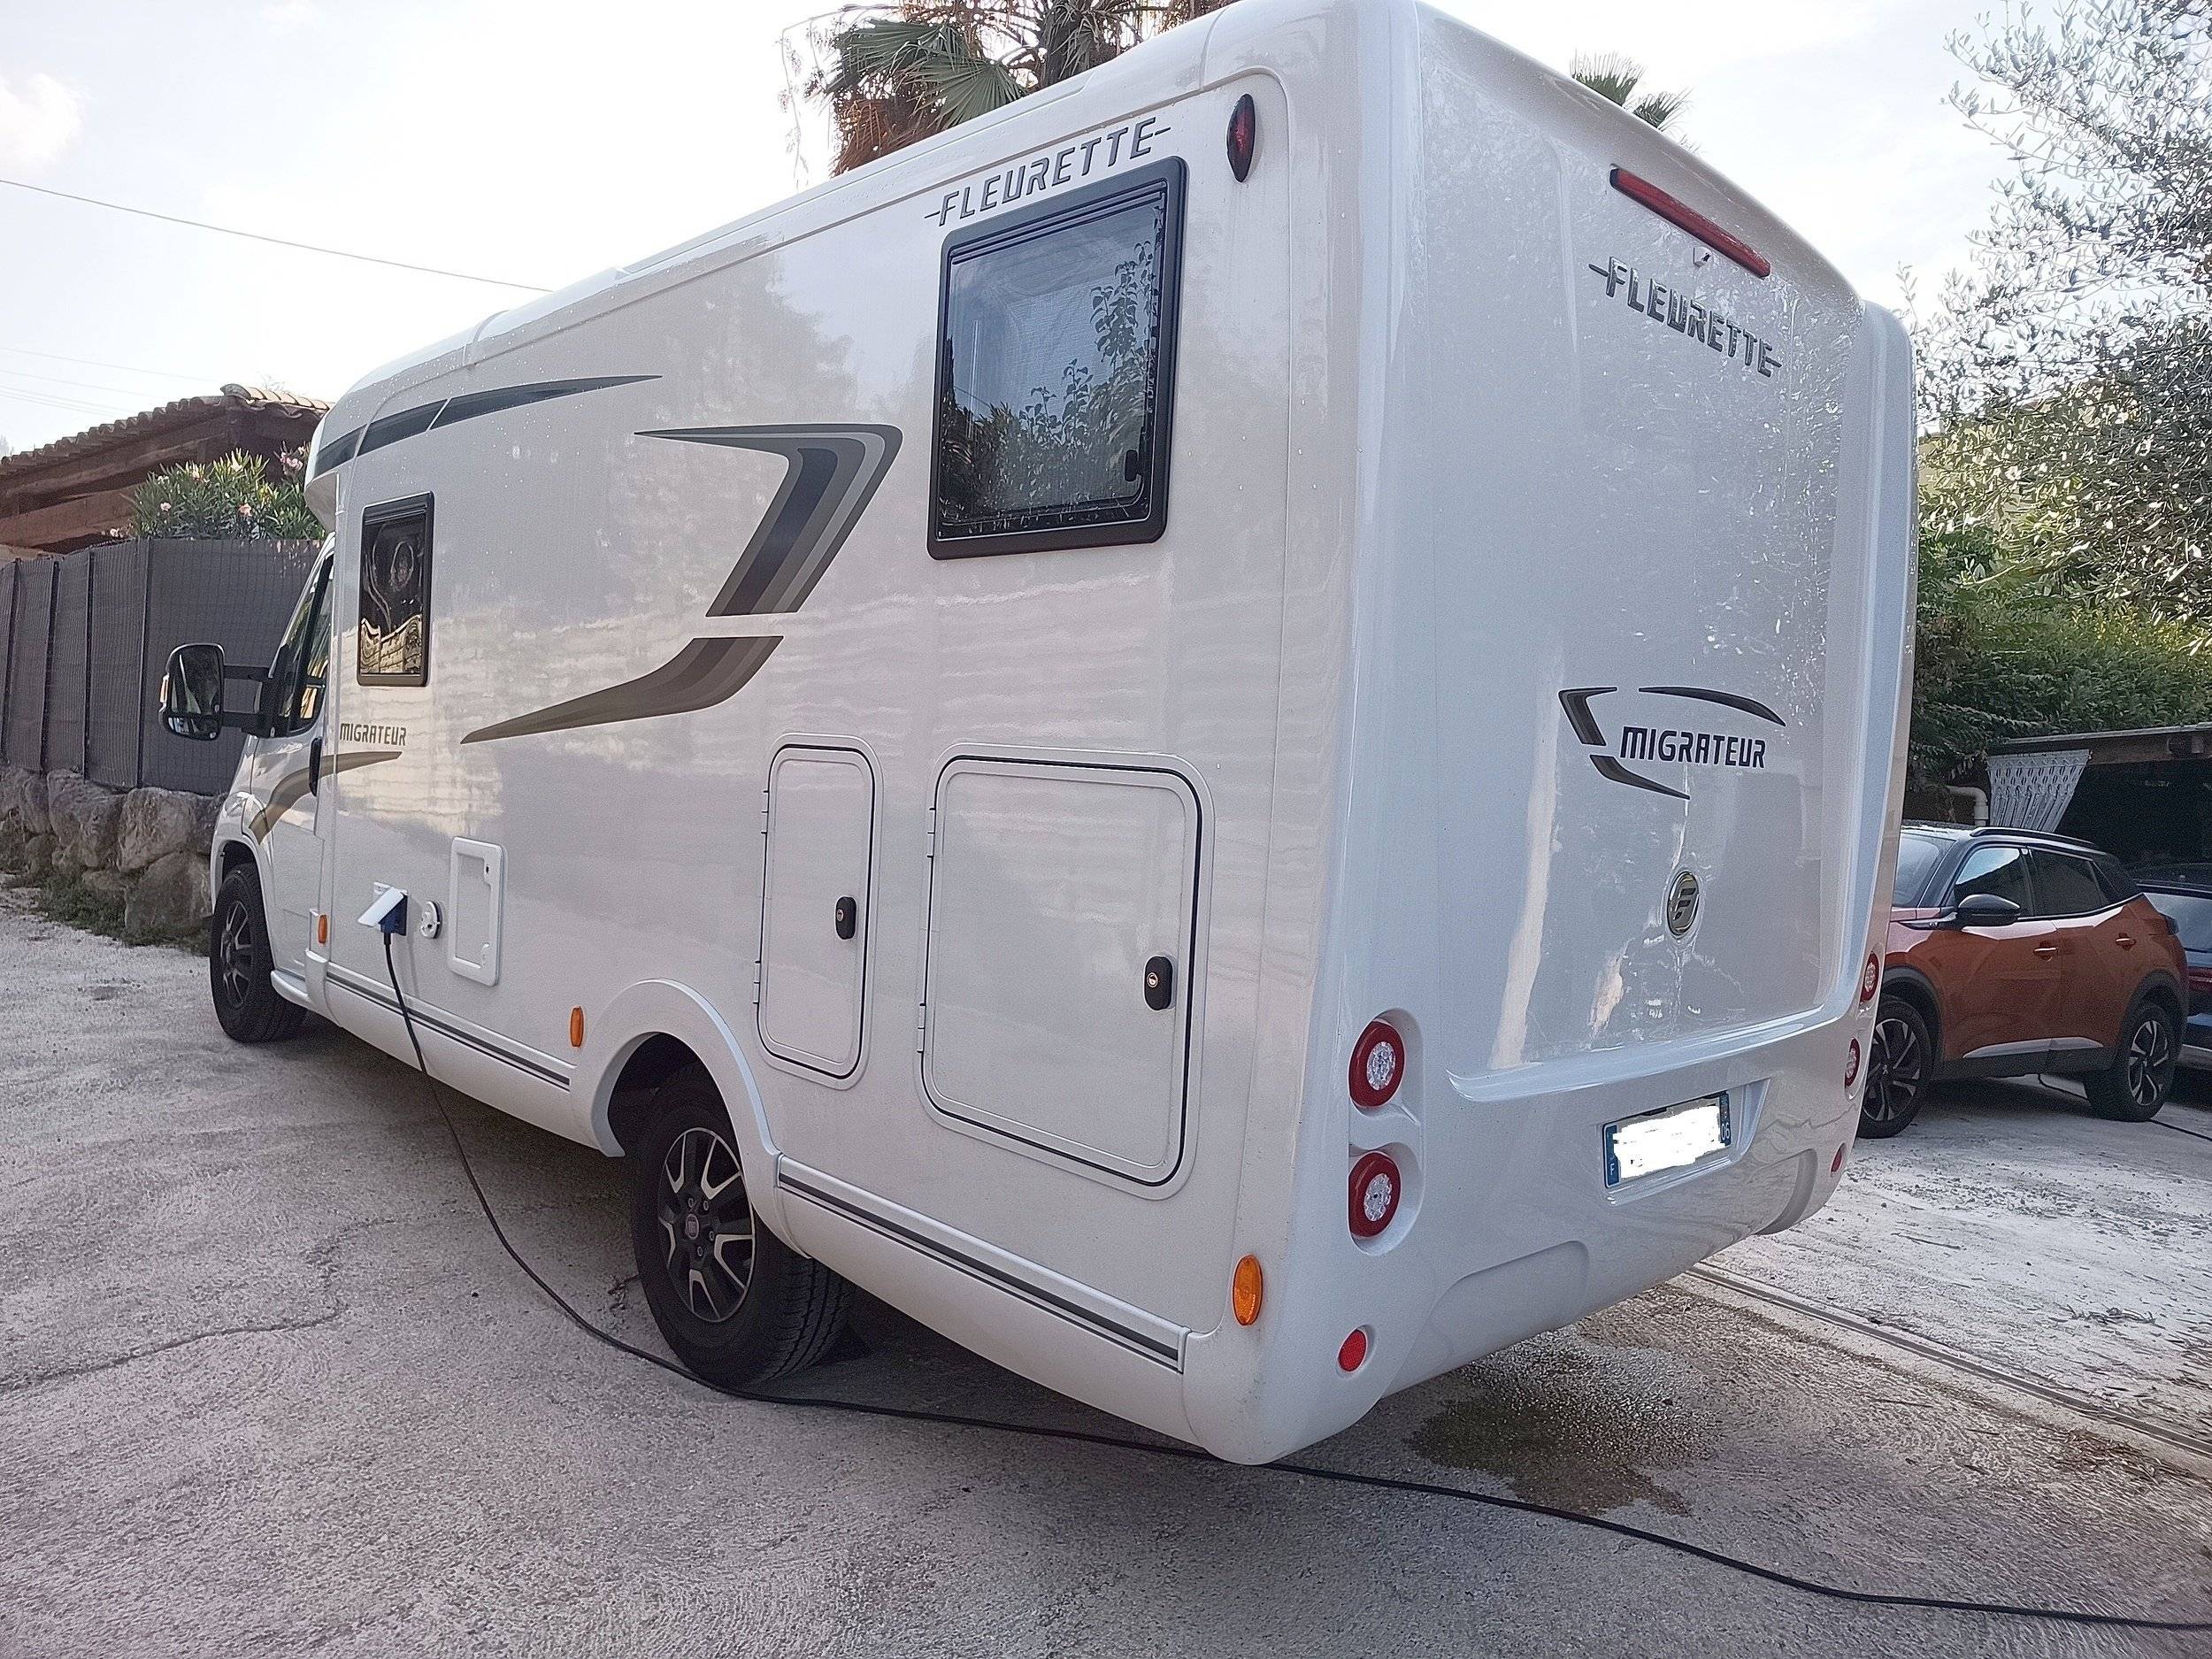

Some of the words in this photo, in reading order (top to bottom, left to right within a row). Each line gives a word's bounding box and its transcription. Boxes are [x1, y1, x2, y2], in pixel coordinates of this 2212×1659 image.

[937, 117, 1157, 227] FLEURETTE
[1605, 256, 1774, 378] FLEURETTE
[340, 723, 407, 746] MIGRATEUR
[1620, 726, 1766, 768] MIGRATEUR
